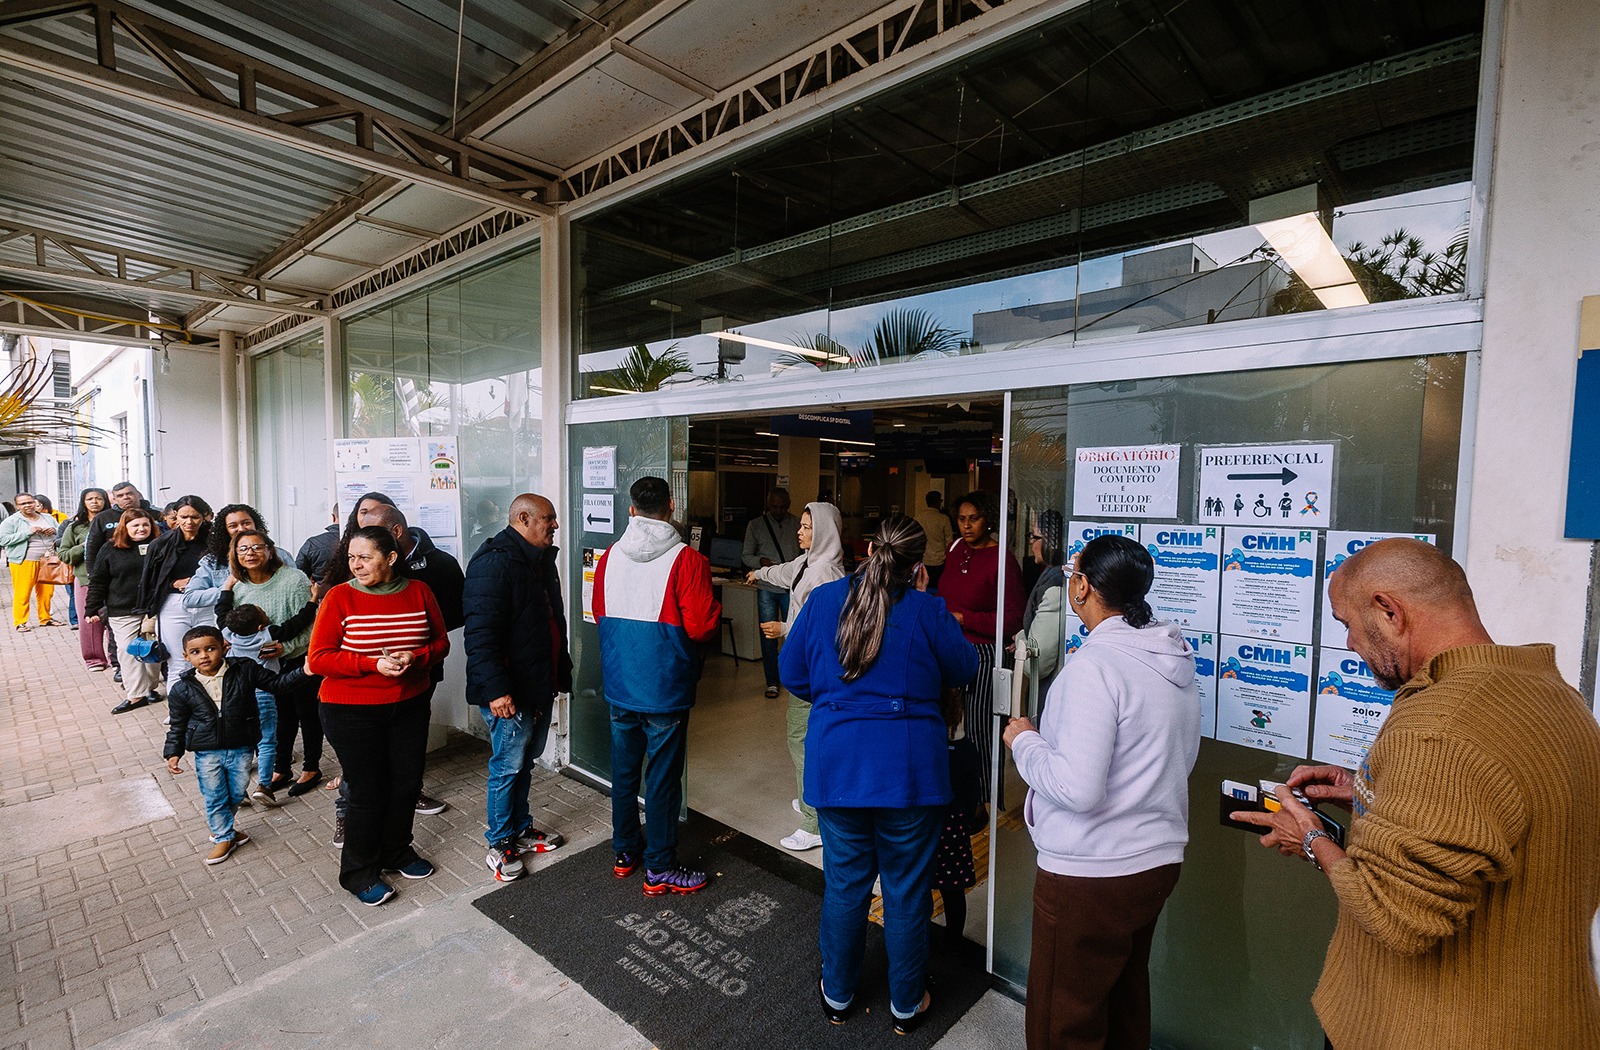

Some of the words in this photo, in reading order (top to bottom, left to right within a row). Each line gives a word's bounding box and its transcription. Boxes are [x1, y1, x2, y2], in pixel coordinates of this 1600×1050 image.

[798, 414, 829, 422] DESCOMPLICA
[1078, 448, 1176, 462] OBRIGATÓRIO
[1205, 453, 1323, 466] PREFERENCIAL
[1093, 465, 1161, 474] DOCUMENTO
[1100, 475, 1123, 483] COM
[1126, 475, 1155, 483] FOTO
[1096, 493, 1135, 503] TÍTULO
[1137, 495, 1152, 503] DE
[1101, 504, 1146, 513] ELEITOR
[691, 533, 700, 541] 05
[1156, 531, 1202, 546] CMH
[1242, 535, 1295, 550] CMH
[1238, 645, 1290, 664] CMH
[1340, 659, 1373, 677] CM
[656, 910, 727, 955] CIDADE
[721, 949, 755, 972] DE
[615, 913, 670, 946] SÃO
[662, 941, 748, 996] PAULO
